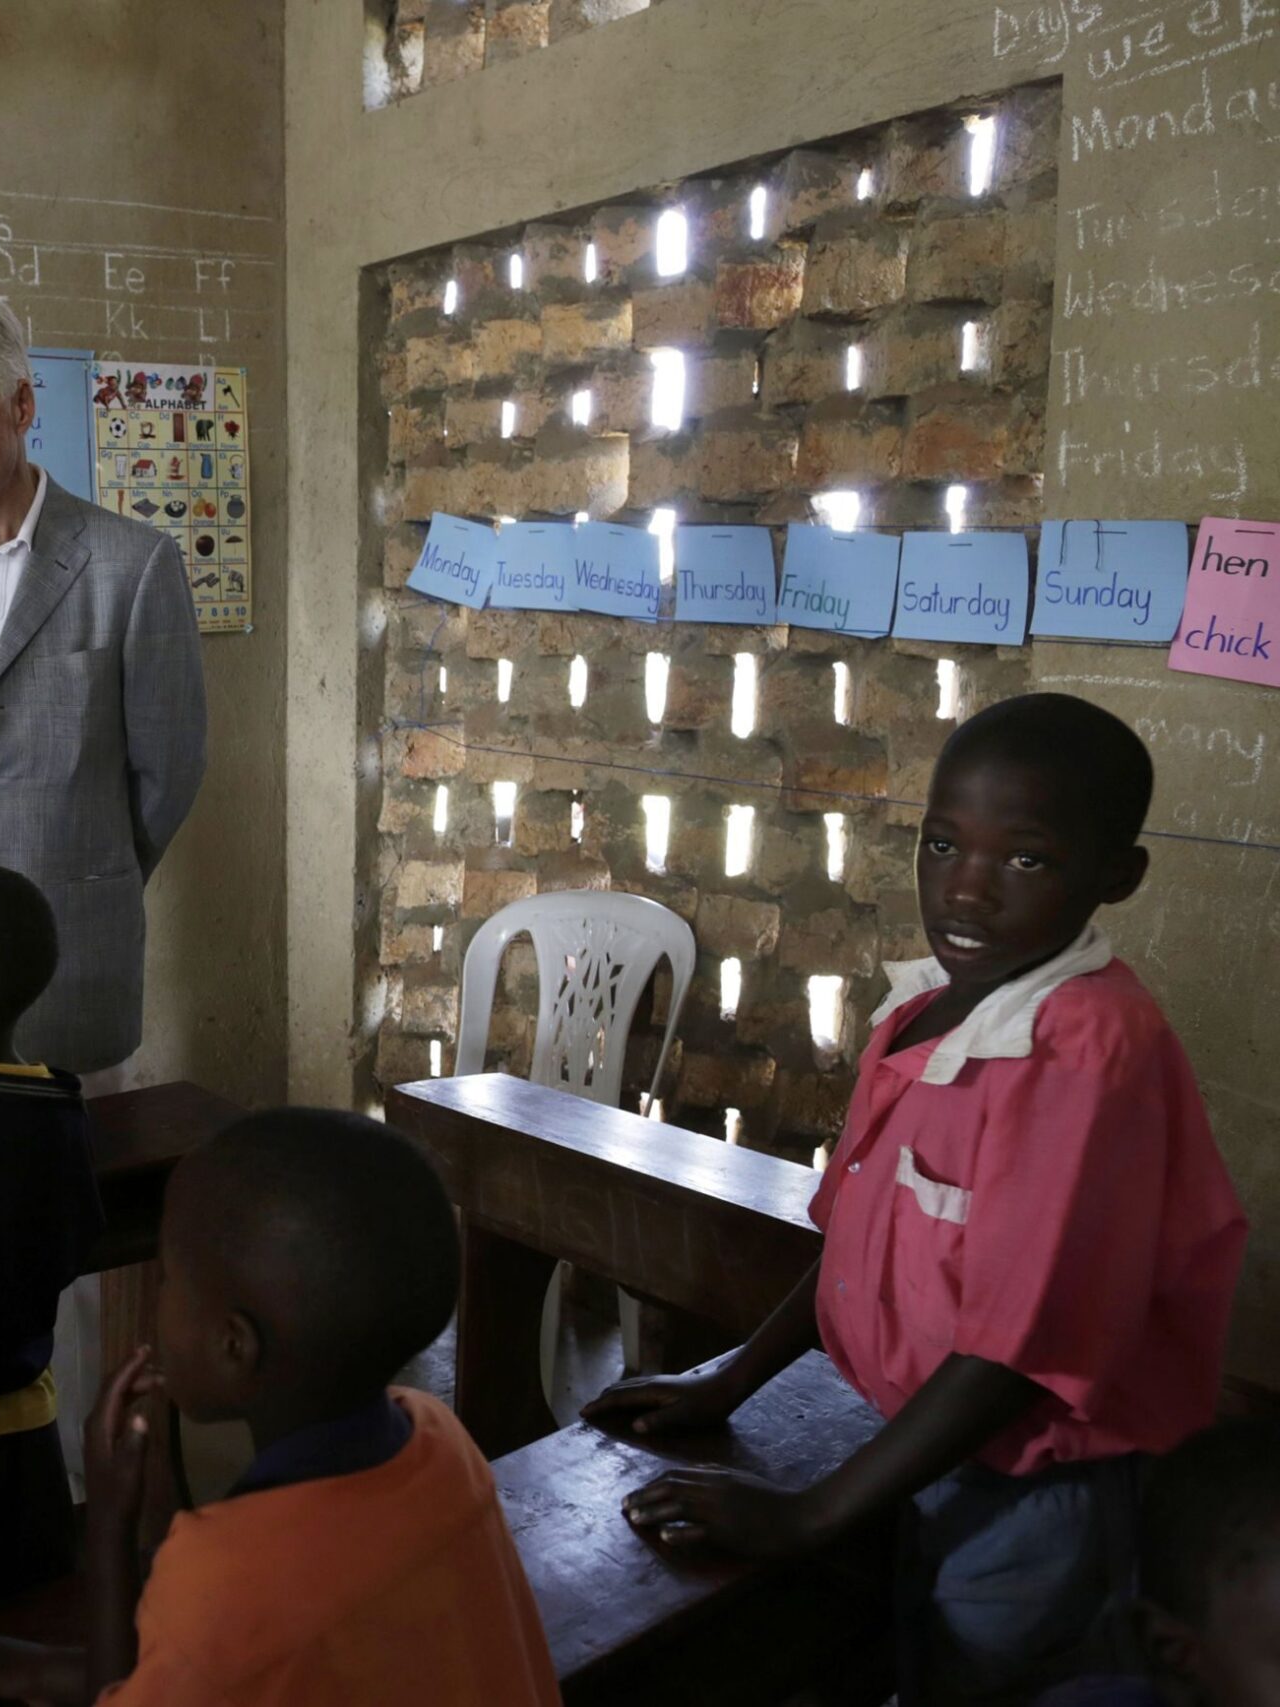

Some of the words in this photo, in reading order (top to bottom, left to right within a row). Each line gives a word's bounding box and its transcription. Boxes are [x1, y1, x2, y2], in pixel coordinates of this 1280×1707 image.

[145, 398, 207, 411] ALPHABET
[420, 541, 481, 597] Monday
[496, 560, 565, 600] Tuesday
[1200, 535, 1270, 578] hen
[574, 558, 660, 614] Wednesday
[679, 569, 767, 617] Thursday
[778, 573, 850, 630] Friday
[903, 581, 1011, 632] Saturday
[1044, 570, 1152, 626] Sunday
[1184, 614, 1271, 660] chick
